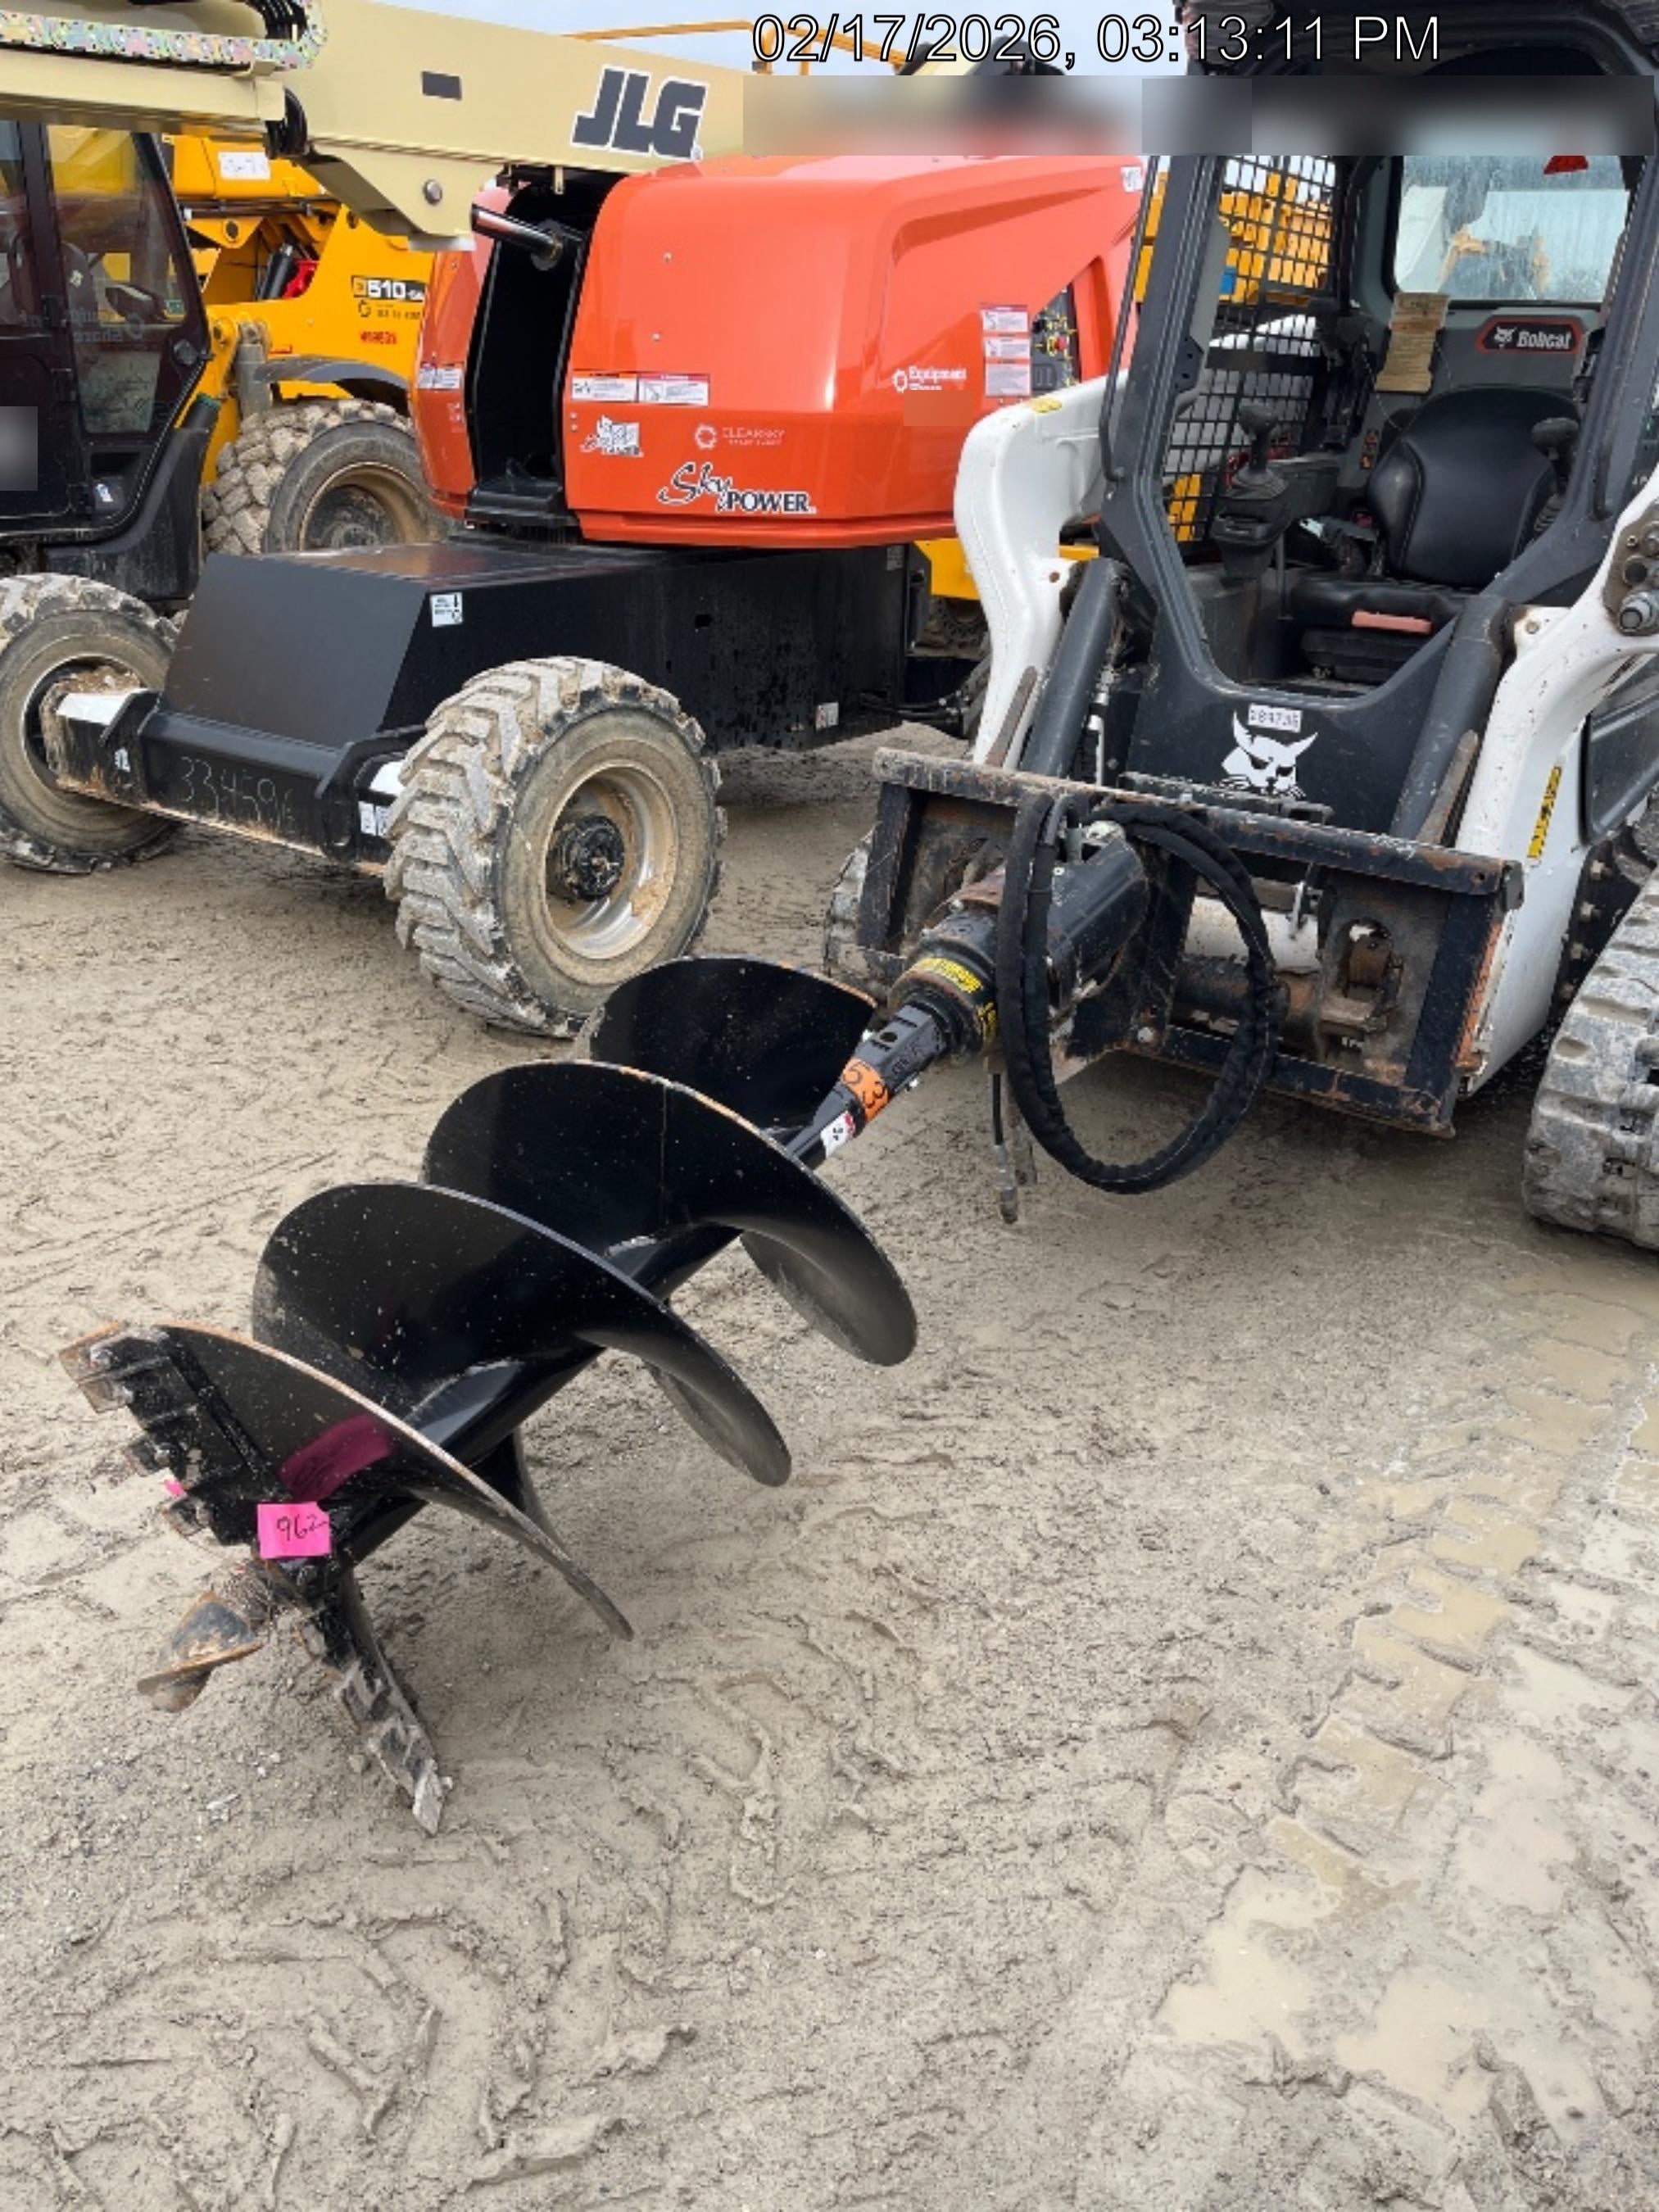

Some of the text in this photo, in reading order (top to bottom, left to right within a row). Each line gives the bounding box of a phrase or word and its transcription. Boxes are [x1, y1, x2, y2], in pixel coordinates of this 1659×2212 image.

[572, 66, 708, 160] JLG
[1516, 329, 1571, 350] Bobcat
[726, 491, 809, 513] POWER
[276, 1513, 329, 1542] 962
